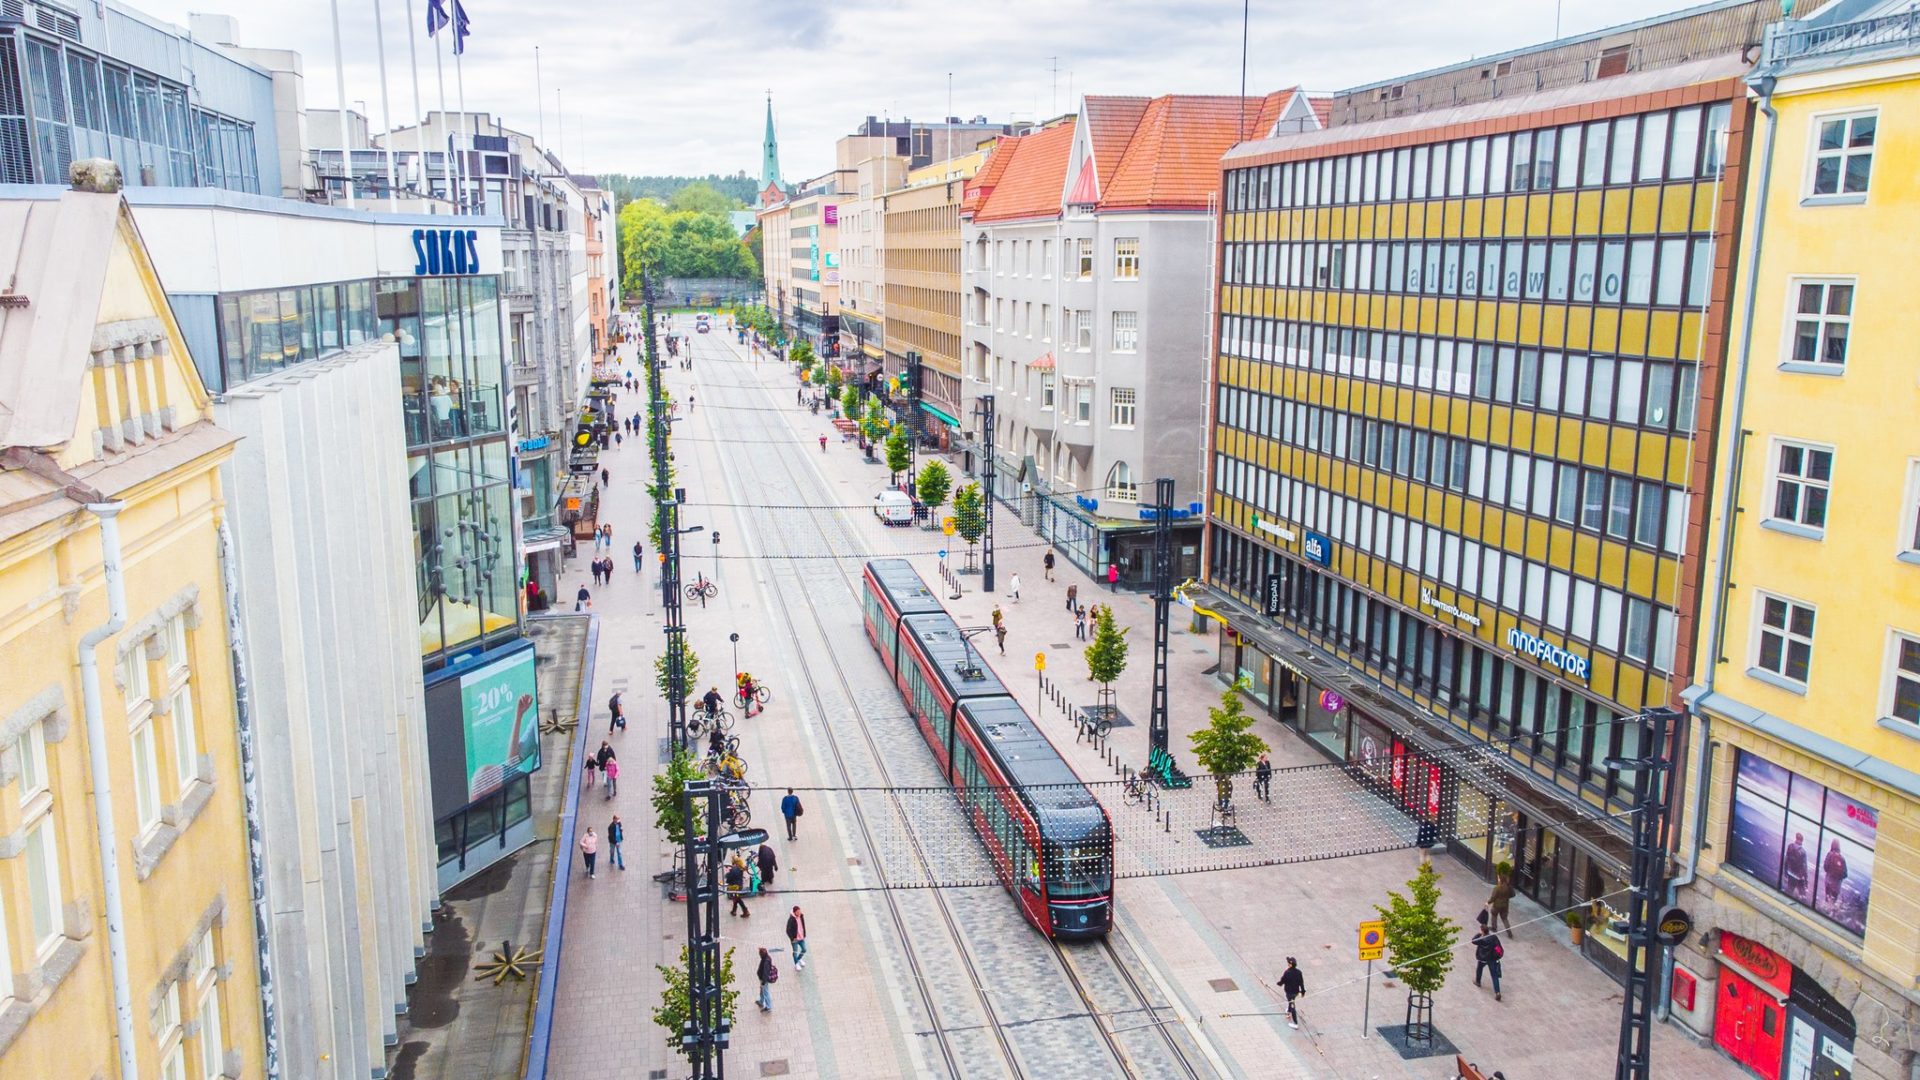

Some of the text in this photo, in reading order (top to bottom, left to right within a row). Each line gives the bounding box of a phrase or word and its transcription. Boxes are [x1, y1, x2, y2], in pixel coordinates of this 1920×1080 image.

[413, 229, 480, 276] SOKOS
[1305, 537, 1322, 558] alfa
[1269, 578, 1279, 613] KappAhl
[1507, 628, 1588, 679] INNOFACTOR
